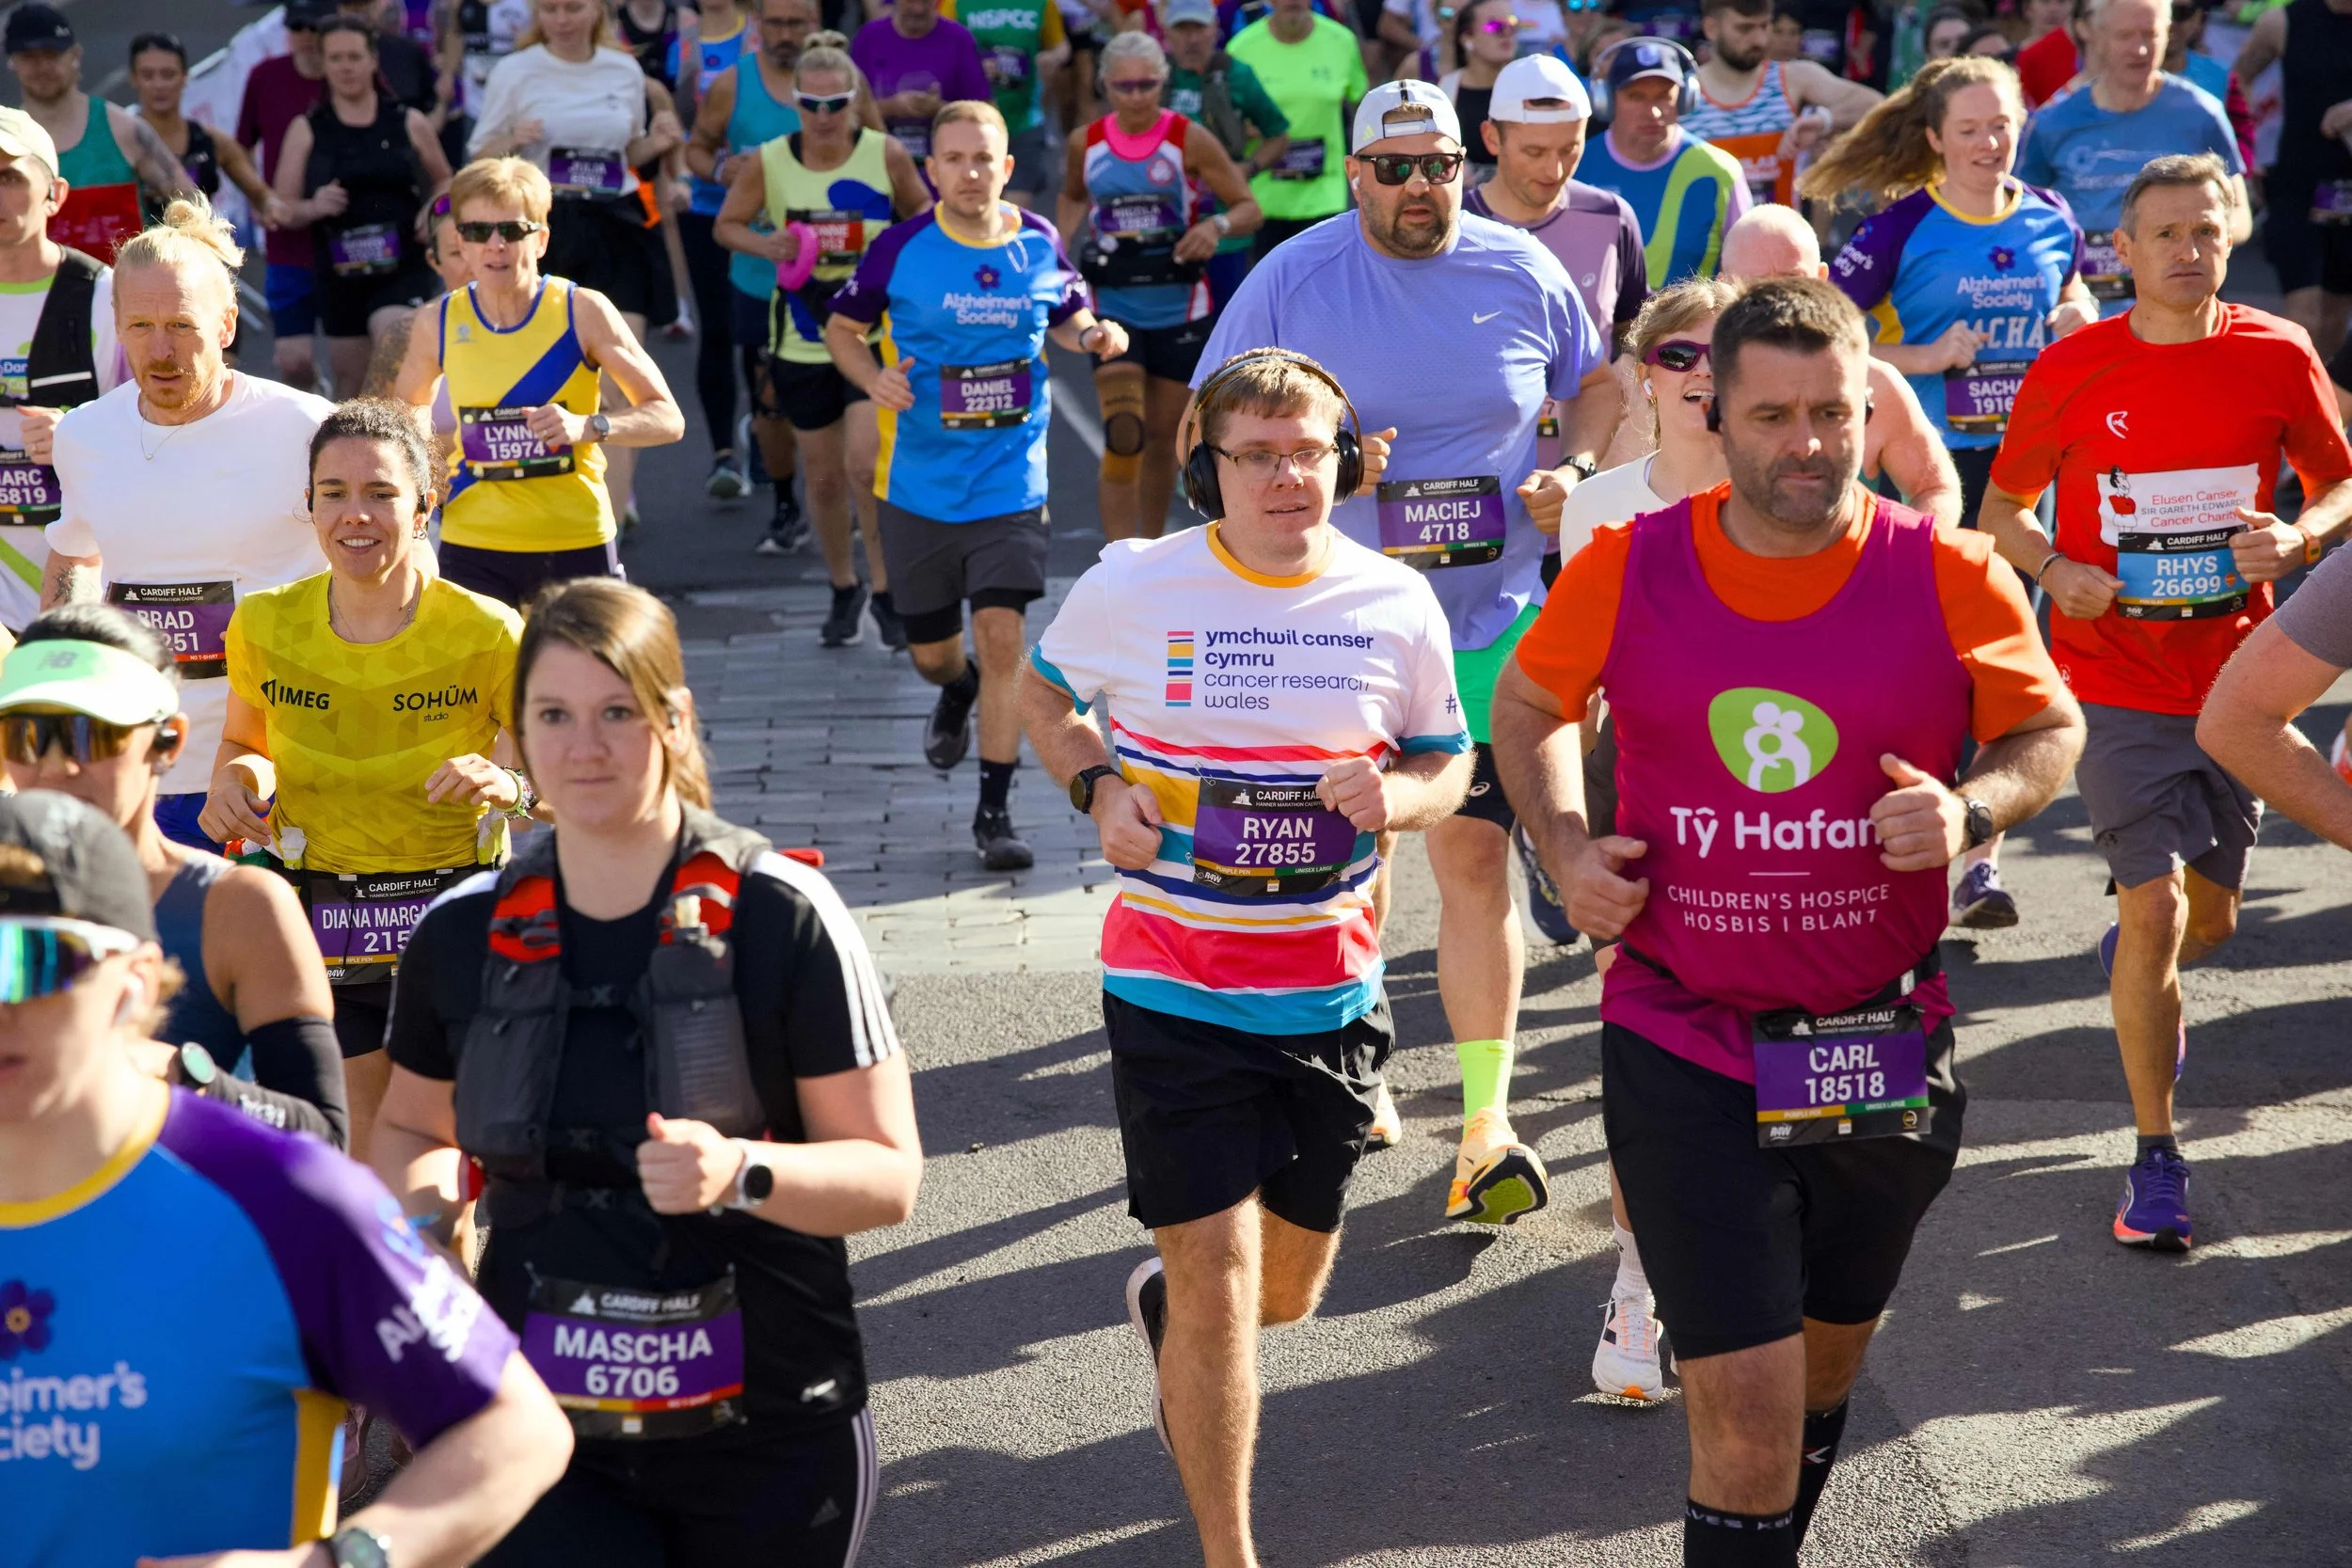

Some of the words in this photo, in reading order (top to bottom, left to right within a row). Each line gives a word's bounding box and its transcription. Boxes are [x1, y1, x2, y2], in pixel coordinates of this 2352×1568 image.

[966, 8, 1039, 30] NSPCC
[942, 293, 1033, 310] Alzheimer's
[1972, 291, 2033, 310] Society
[955, 310, 1019, 329] Society
[1958, 316, 2046, 350] ACHA
[961, 378, 1016, 397] DANIEL
[965, 394, 1014, 412] 22312
[485, 424, 539, 443] LYNN
[488, 441, 546, 460] 15974
[0, 468, 42, 486] ARC
[1423, 481, 1457, 490] CARDIFF
[1459, 479, 1479, 488] HALF
[2153, 494, 2193, 505] Elusen
[2196, 488, 2238, 501] Canser
[1405, 500, 1481, 523] MACIEJ
[2141, 507, 2156, 515] SIR
[2159, 503, 2200, 515] GARETH
[2151, 515, 2195, 528] Cancer
[2198, 511, 2237, 524] Charity
[1419, 521, 1470, 543] 4718
[2167, 534, 2205, 546] CARDIFF
[2206, 531, 2228, 543] HALF
[2156, 556, 2218, 577] RHYS
[140, 588, 176, 596] CARDIFF
[179, 587, 203, 596] HALF
[2152, 576, 2221, 597] 26699
[1205, 627, 1298, 647] ymchwil
[1302, 633, 1375, 649] canser
[1204, 651, 1275, 670] cymru
[1204, 673, 1279, 689] cancer
[1281, 673, 1370, 692] research
[279, 686, 330, 710] IMEG
[392, 684, 478, 712] SOHÜM
[1204, 692, 1270, 710] wales
[423, 711, 449, 722] studio
[1256, 790, 1302, 801] CARDIFF
[1243, 816, 1313, 839] RYAN
[1734, 808, 1883, 850] Hafan
[1234, 842, 1316, 865] 27855
[1315, 864, 1333, 873] LARGE
[369, 880, 411, 892] CARDIFF
[1667, 884, 1793, 911] CHILDREN'S
[1800, 883, 1890, 910] HOSPICE
[323, 908, 372, 929] DIANA
[1683, 911, 1772, 933] HOSBIS
[1783, 917, 1788, 933] I
[1802, 909, 1878, 932] BLANT
[1816, 1013, 1865, 1027] CARDIFF
[1867, 1009, 1897, 1023] HALF
[1808, 1043, 1881, 1073] CARL
[1804, 1070, 1885, 1104] 18518
[600, 1292, 660, 1312] CARDIFF
[661, 1293, 702, 1311] HALF
[553, 1323, 713, 1364] MASCHA
[585, 1363, 680, 1398] 6706
